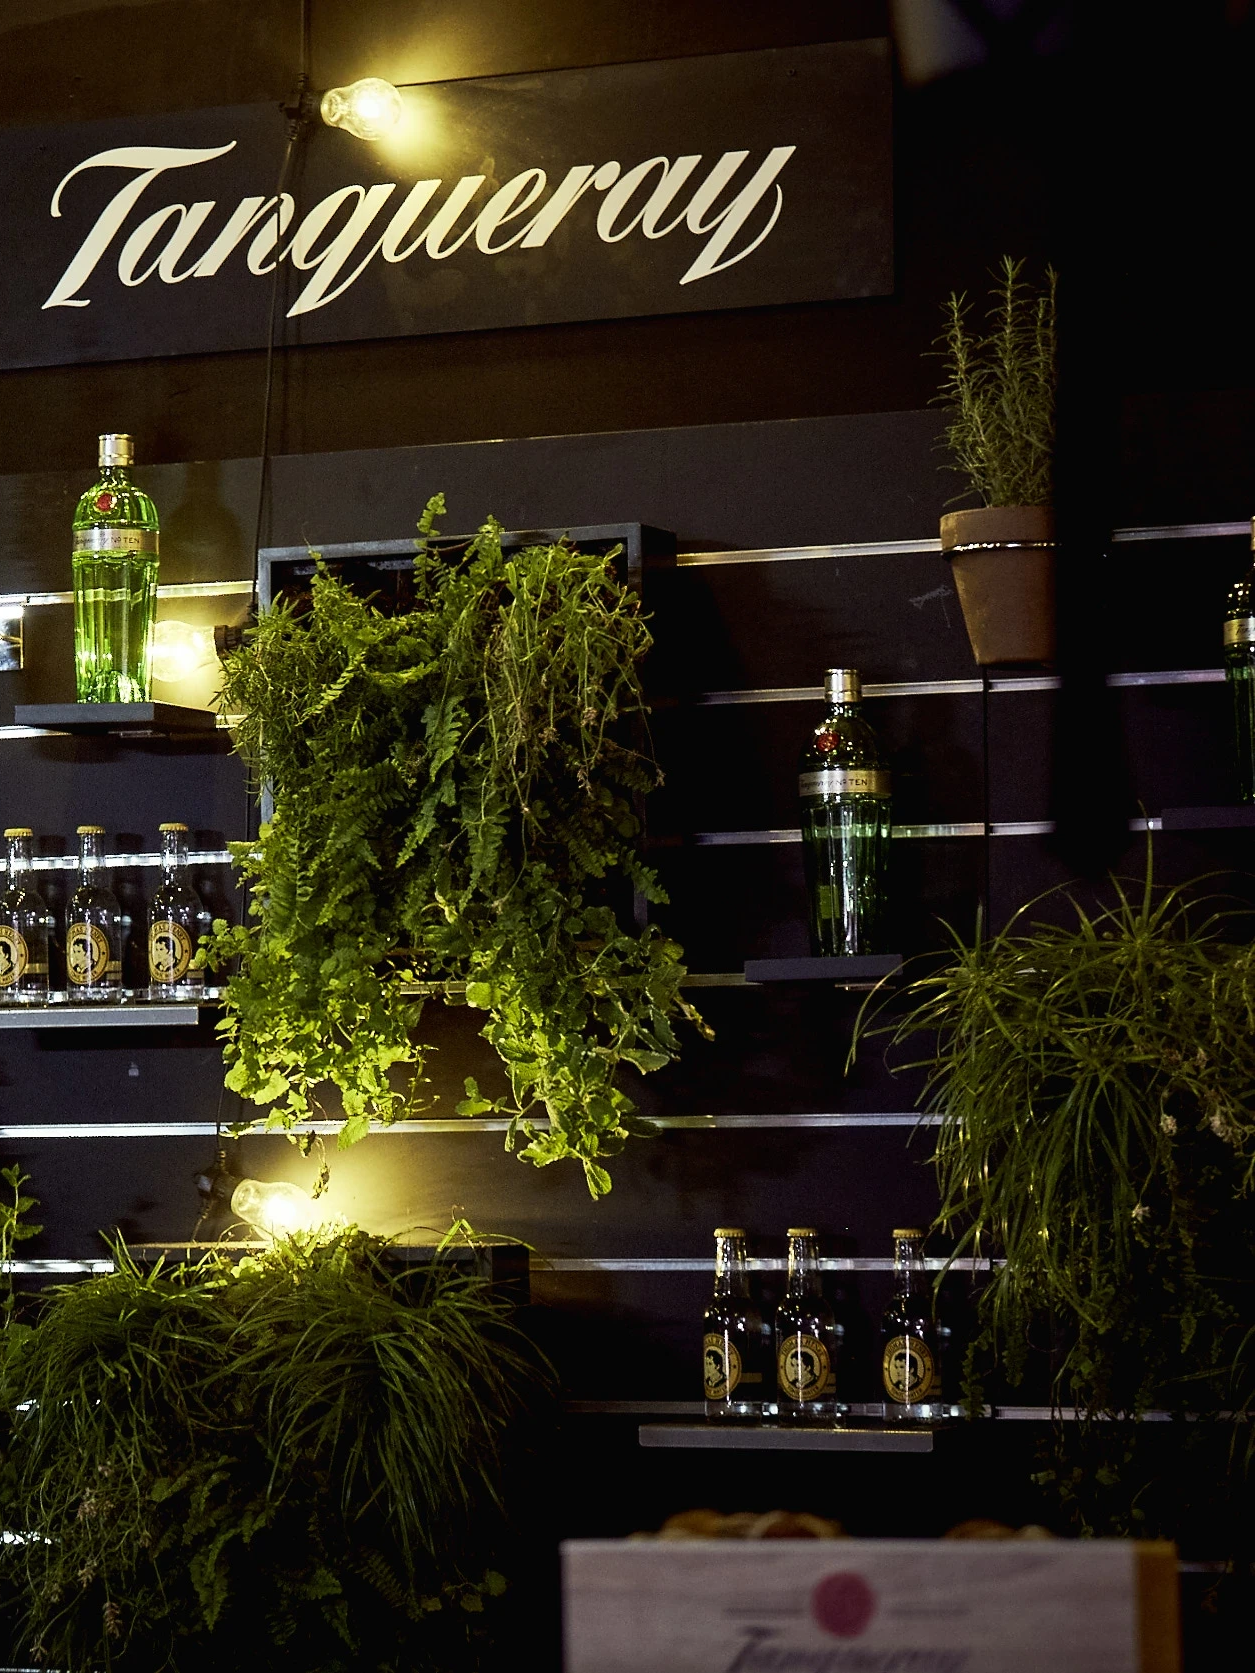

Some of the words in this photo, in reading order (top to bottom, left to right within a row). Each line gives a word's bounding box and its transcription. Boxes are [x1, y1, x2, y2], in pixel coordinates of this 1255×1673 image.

[41, 139, 797, 318] Tanqueray
[123, 536, 140, 544] TEN
[848, 778, 868, 786] TEN
